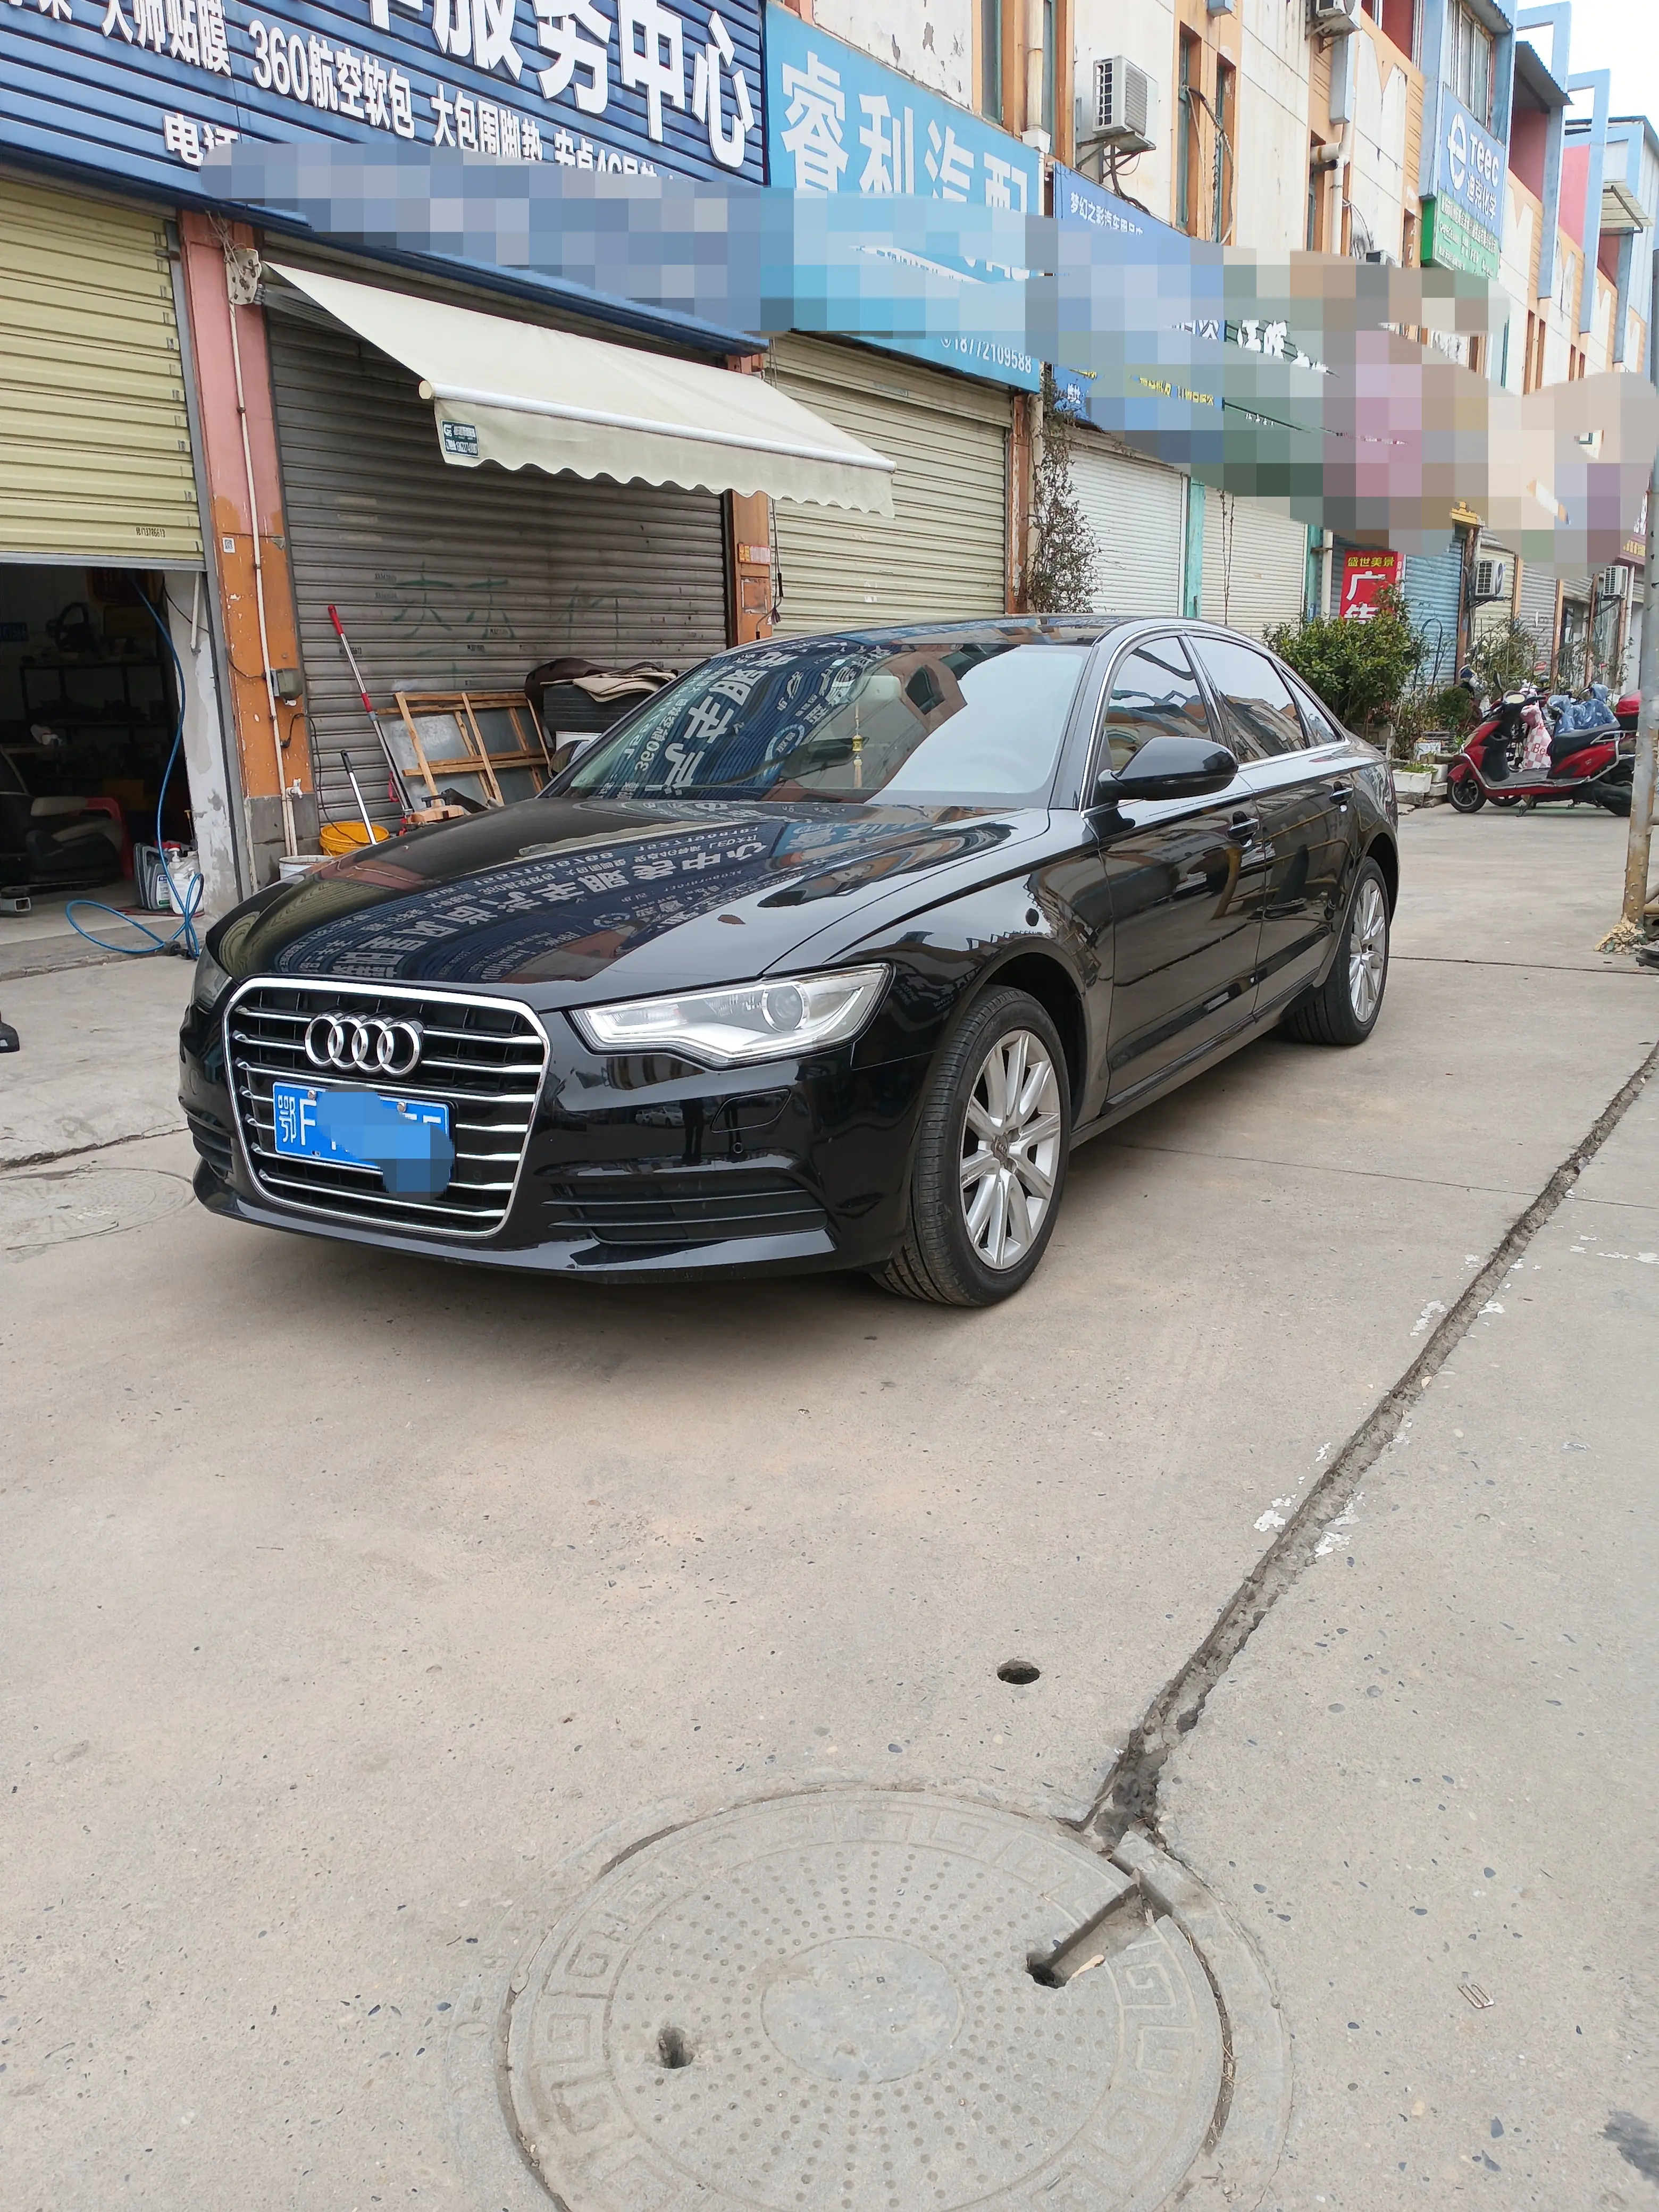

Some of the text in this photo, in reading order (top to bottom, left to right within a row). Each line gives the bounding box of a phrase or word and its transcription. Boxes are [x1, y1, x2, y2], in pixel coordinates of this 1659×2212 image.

[249, 20, 416, 139] 360航空软包
[782, 52, 1028, 213] 睿利汽配
